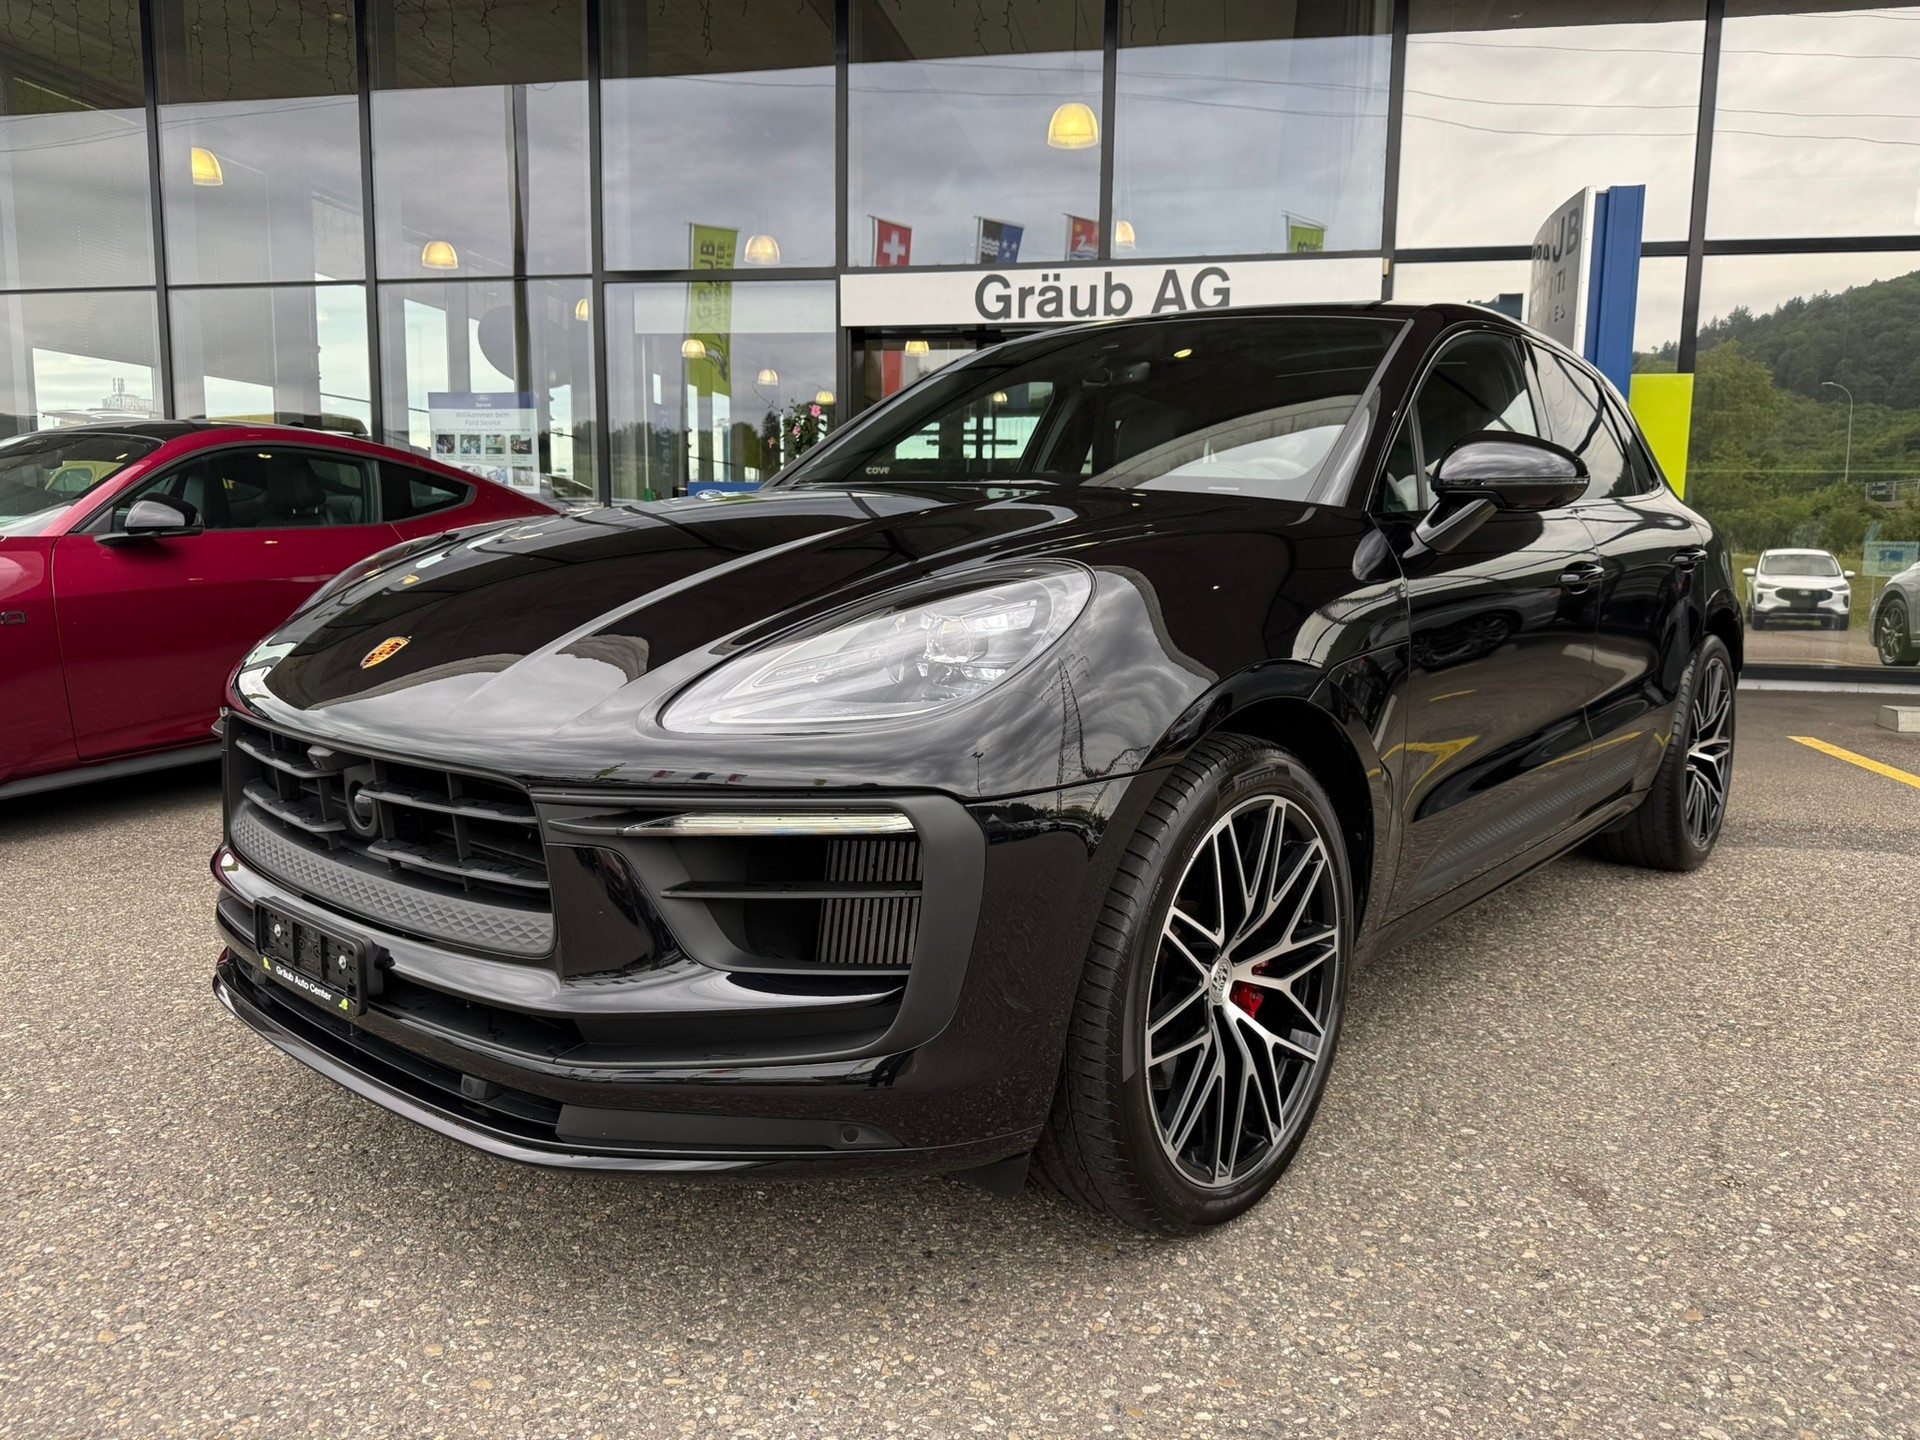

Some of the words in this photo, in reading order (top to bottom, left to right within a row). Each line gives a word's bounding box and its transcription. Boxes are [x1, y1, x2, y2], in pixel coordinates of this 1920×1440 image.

[974, 270, 1134, 321] Gräub
[1150, 266, 1231, 315] AG
[295, 976, 308, 989] Auto
[310, 983, 331, 1000] Center
